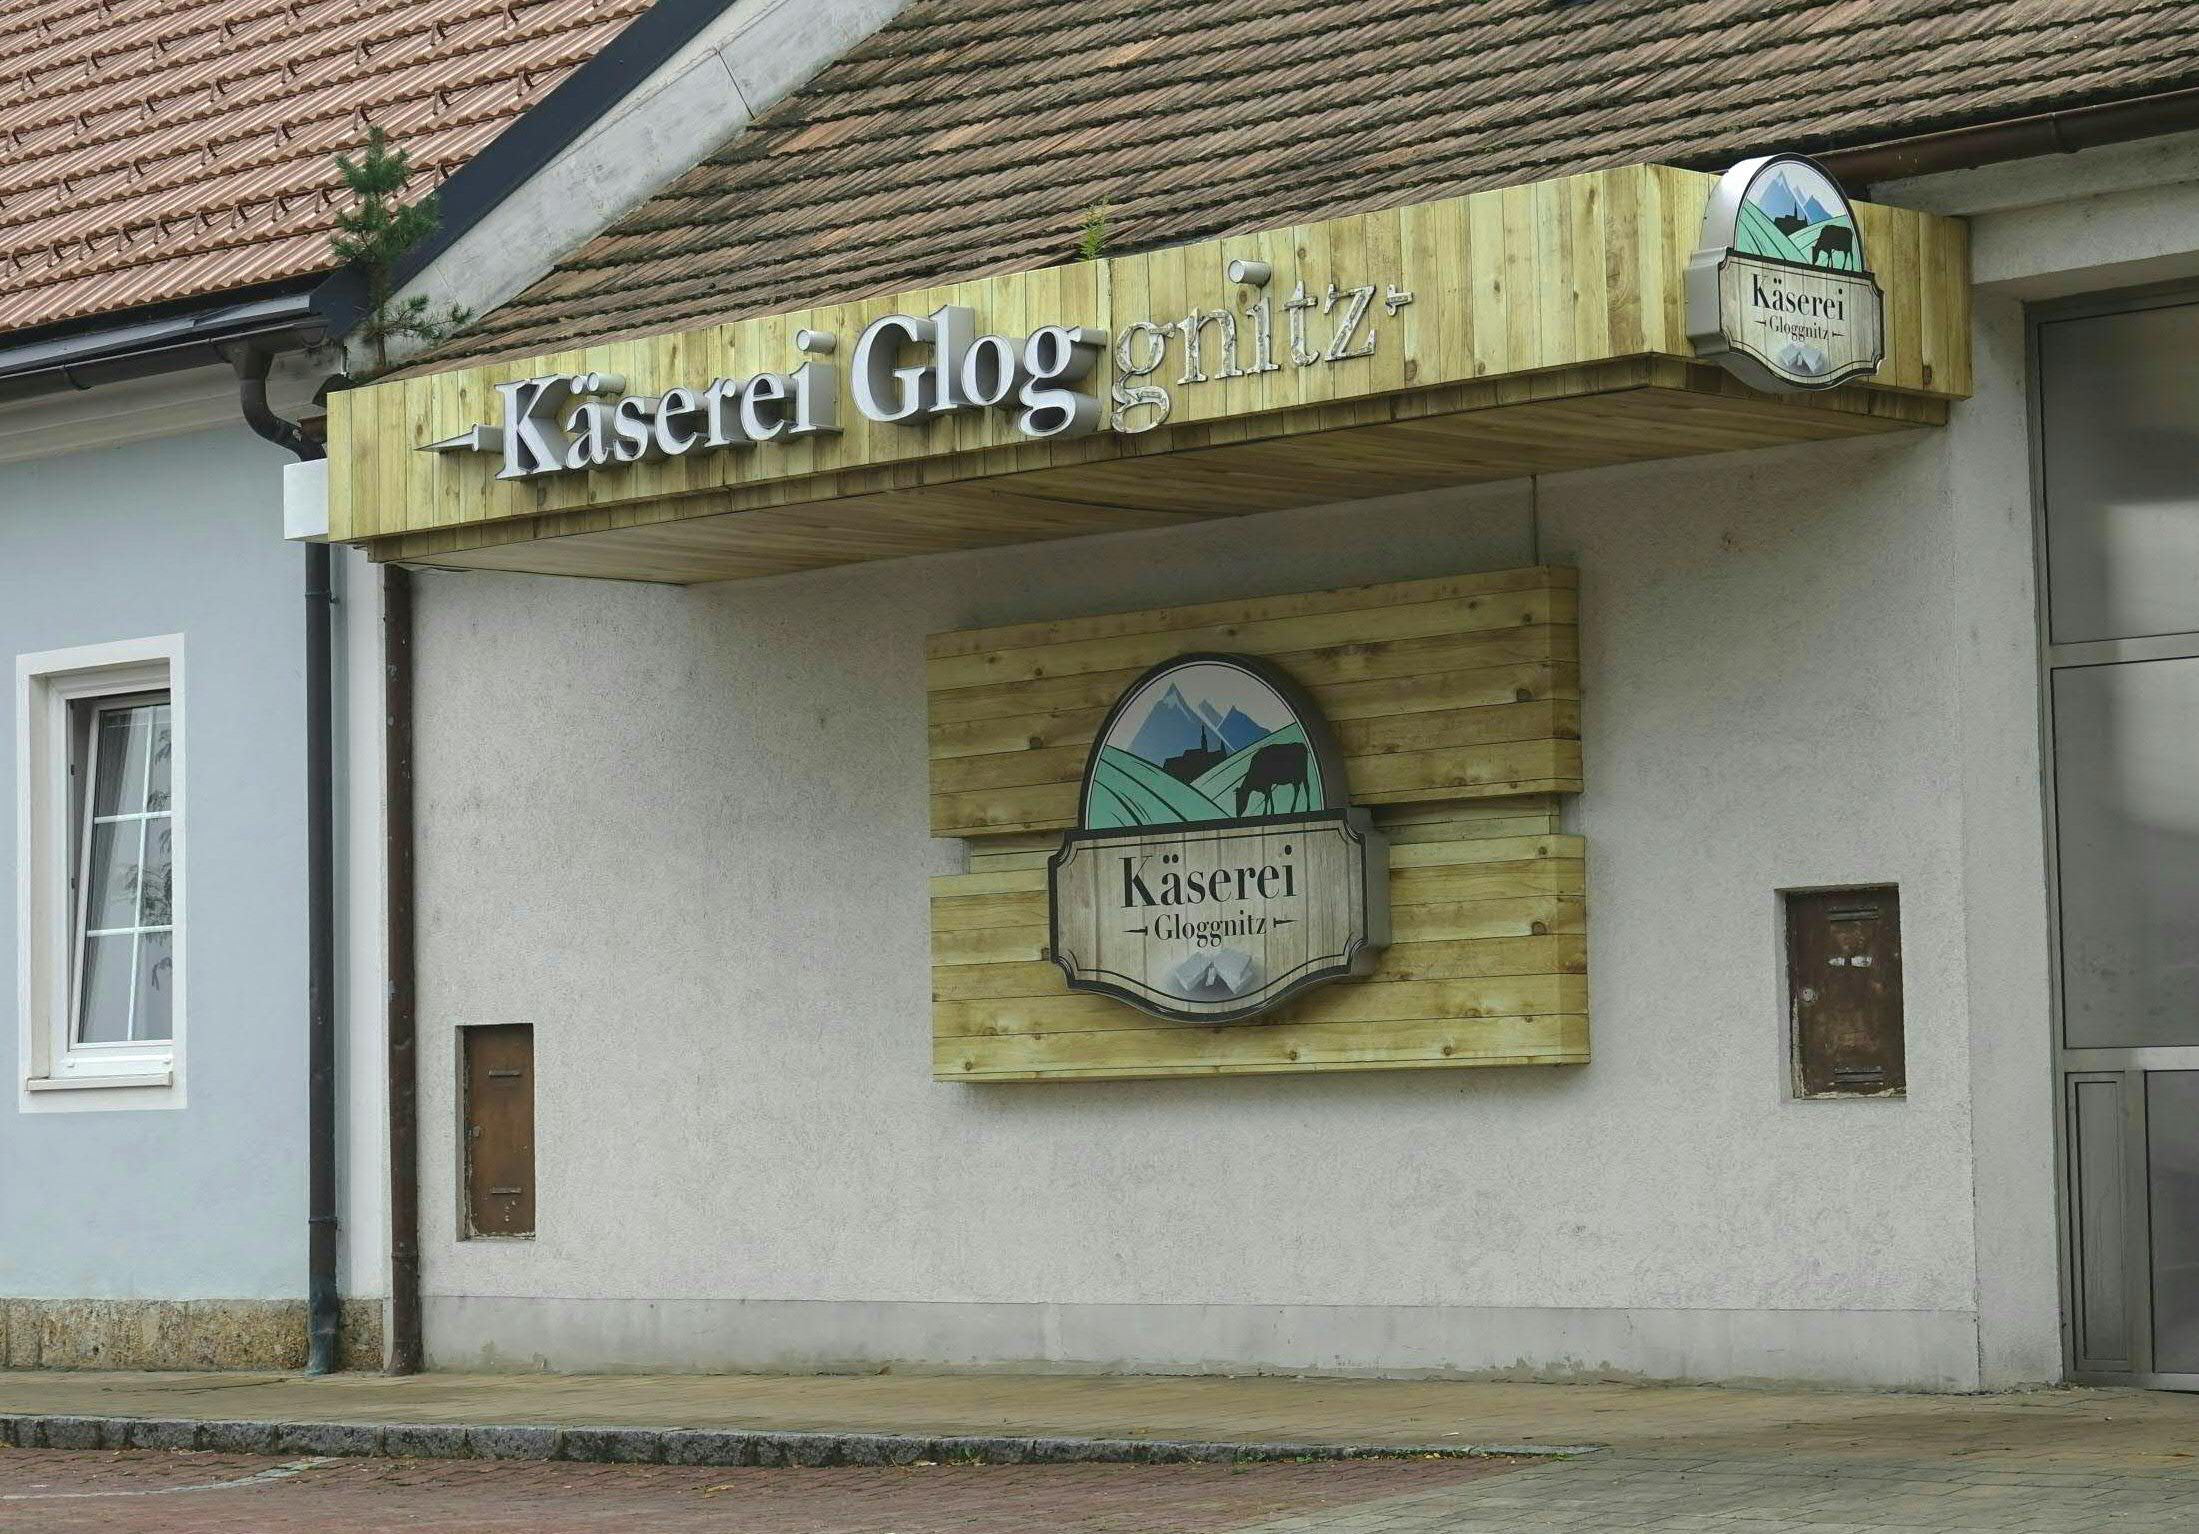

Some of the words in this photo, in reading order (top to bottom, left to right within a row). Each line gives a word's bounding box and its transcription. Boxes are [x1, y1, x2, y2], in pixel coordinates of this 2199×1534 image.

[1752, 273, 1845, 321] Käserei
[1769, 315, 1829, 341] Gloggnitz
[495, 328, 840, 481] Käserei
[850, 259, 1377, 437] Gloggnitz
[1119, 844, 1297, 908] Käserei
[1154, 909, 1268, 948] Gloggnitz
